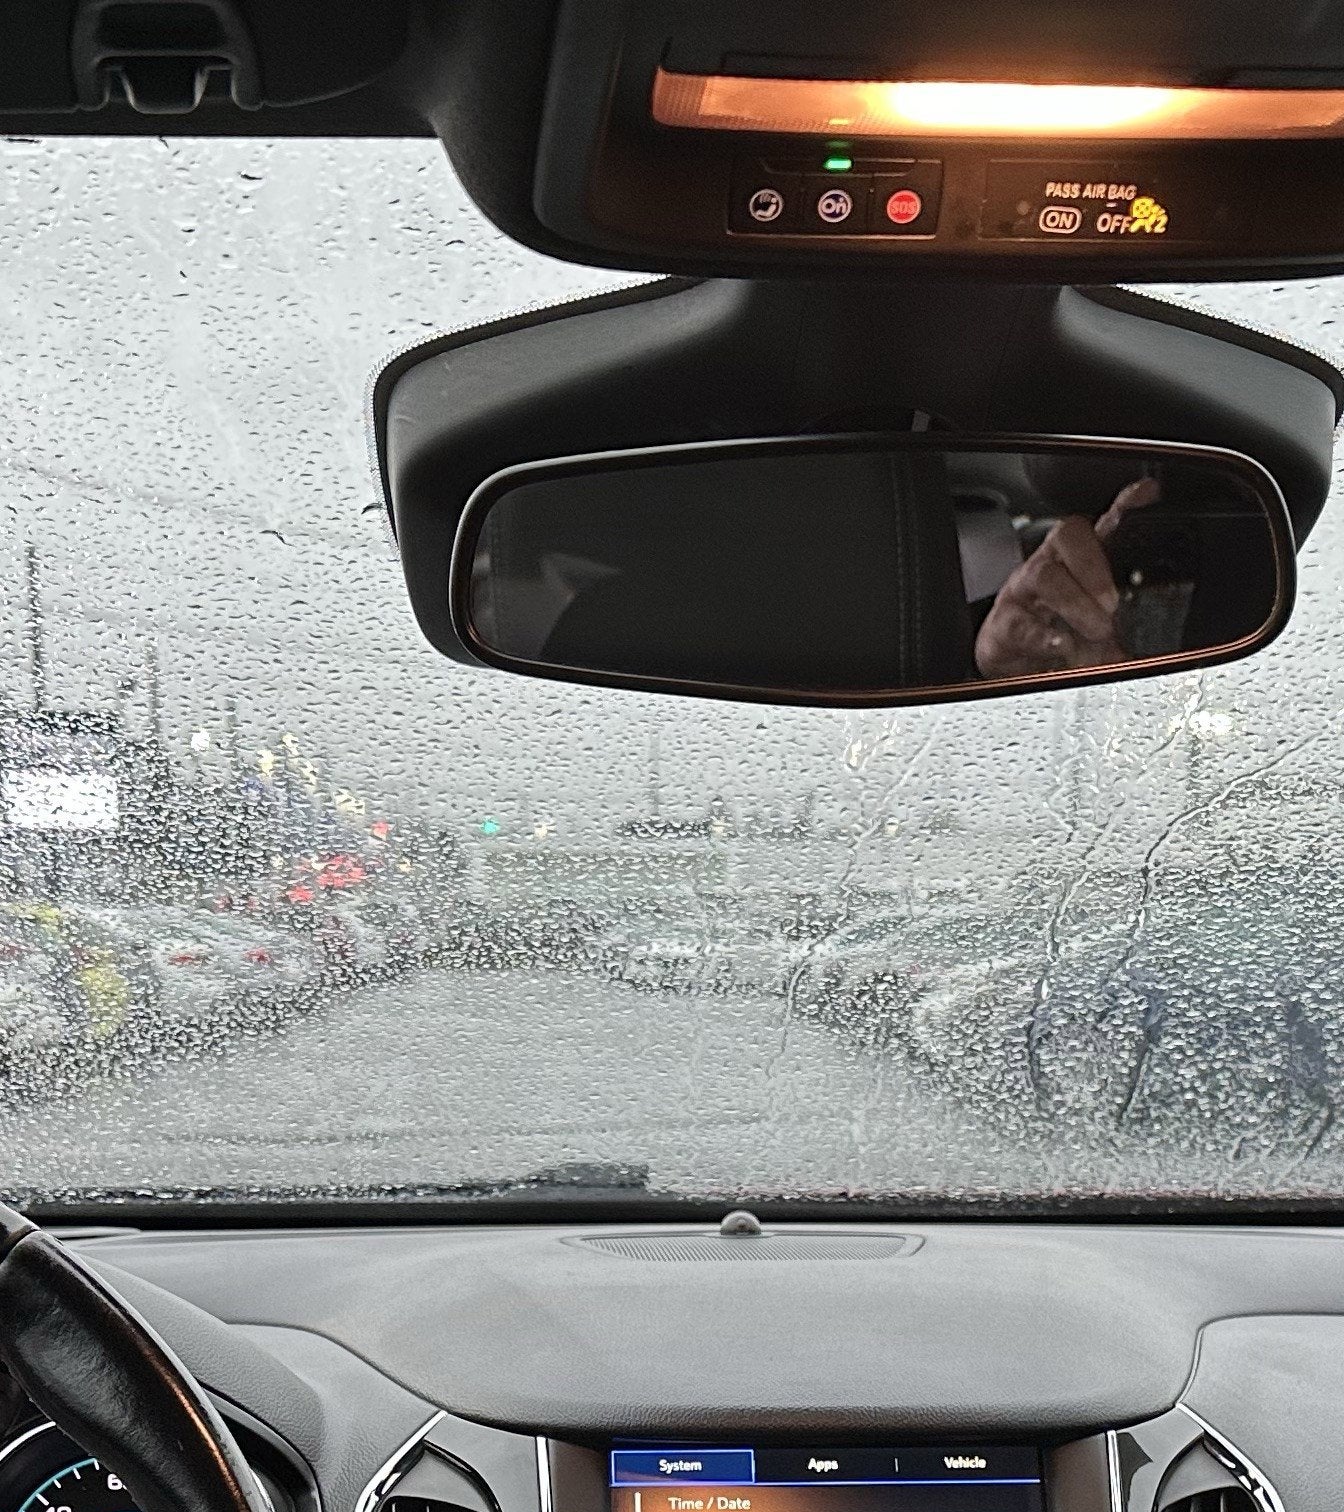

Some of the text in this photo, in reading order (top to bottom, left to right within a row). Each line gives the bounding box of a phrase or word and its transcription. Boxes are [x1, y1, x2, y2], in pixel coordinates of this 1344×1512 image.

[1046, 181, 1137, 200] PASS AIR BAG
[890, 201, 918, 215] SOS
[1045, 211, 1075, 228] ON
[1096, 212, 1133, 234] OFF
[659, 1459, 703, 1474] System
[808, 1458, 839, 1472] Apps
[943, 1456, 987, 1470] Vehicle
[107, 1473, 128, 1490] 6
[668, 1497, 704, 1511] Time
[717, 1497, 752, 1511] Date
